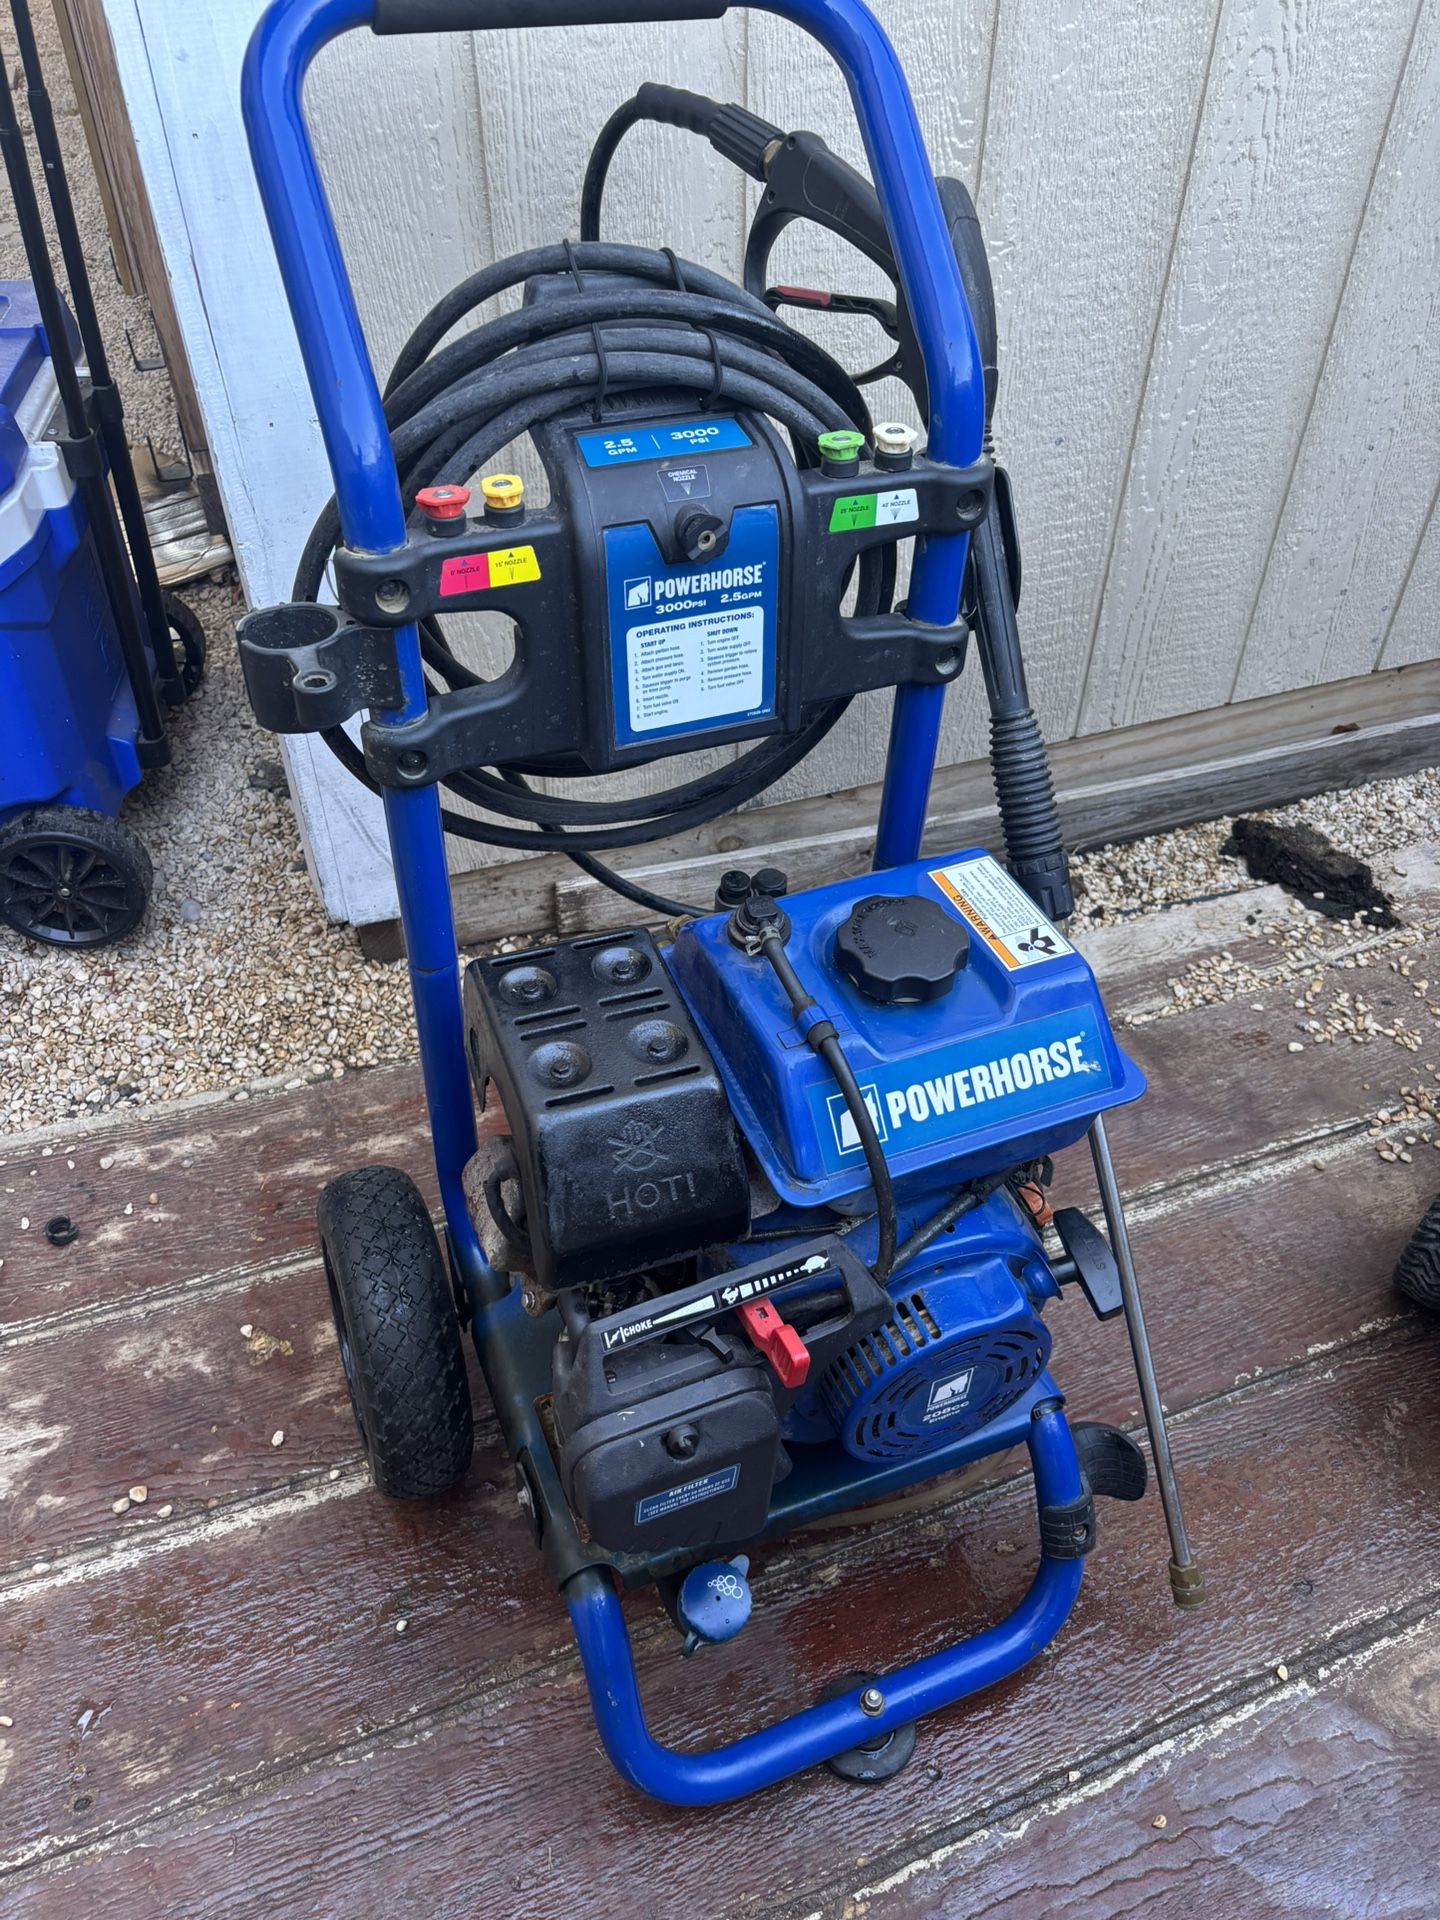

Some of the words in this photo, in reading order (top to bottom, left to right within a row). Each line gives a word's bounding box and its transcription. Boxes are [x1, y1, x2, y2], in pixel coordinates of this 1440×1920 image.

[670, 427, 719, 439] 3000
[603, 438, 634, 449] 2.5
[689, 437, 709, 445] PSI
[608, 445, 637, 455] GPM
[668, 469, 698, 479] CHEMICAL
[672, 474, 696, 482] NOZZLE
[505, 558, 527, 566] NOZZLE
[457, 566, 479, 574] NOZZLE
[654, 565, 762, 600] POWERHORSE
[656, 599, 706, 614] 3000PSI
[720, 591, 762, 603] 2.5GPM
[636, 623, 685, 638] OPERATING
[689, 611, 754, 629] INSTRUCTIONS:
[707, 629, 720, 637] SHUT
[641, 640, 657, 648] START
[952, 895, 992, 935] WARNING
[886, 1036, 1086, 1129] POWERHORSE
[605, 1172, 696, 1219] HOT!
[624, 1320, 653, 1336] CHOKE
[929, 1410, 960, 1423] Engine
[670, 1488, 682, 1497] AIR
[683, 1478, 708, 1492] FILTER
